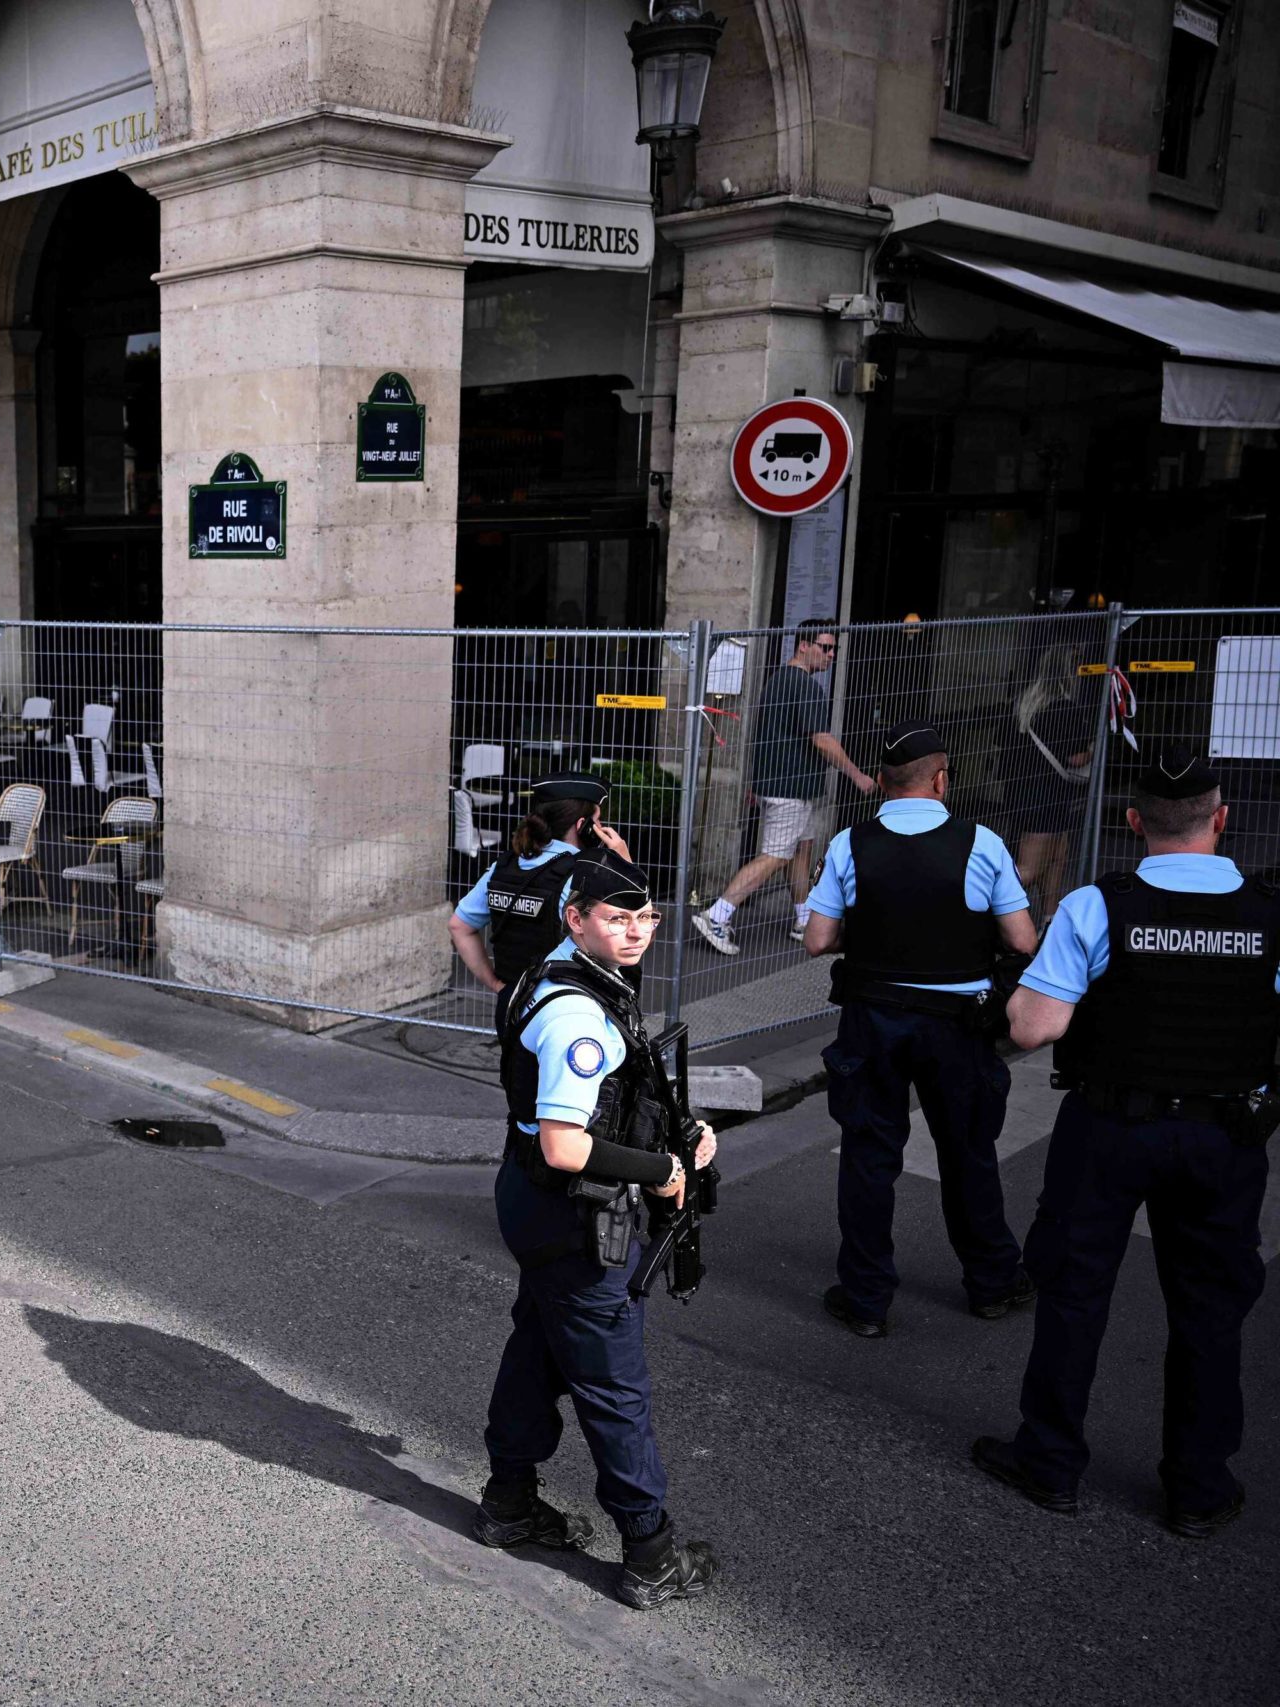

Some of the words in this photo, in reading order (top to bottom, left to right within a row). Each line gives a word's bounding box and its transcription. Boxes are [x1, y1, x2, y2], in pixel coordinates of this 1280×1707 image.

[41, 132, 85, 170] DES
[464, 213, 510, 245] DES
[518, 218, 639, 256] TUILERIES
[386, 422, 398, 433] RUE
[362, 450, 397, 462] VINGT-NEUF
[399, 450, 420, 462] JUILLET
[772, 469, 790, 482] 10
[792, 474, 802, 482] m
[223, 500, 248, 518] RUE
[208, 526, 224, 543] DE
[226, 525, 263, 543] RIVOLI
[1130, 927, 1264, 956] GENDARMERIE
